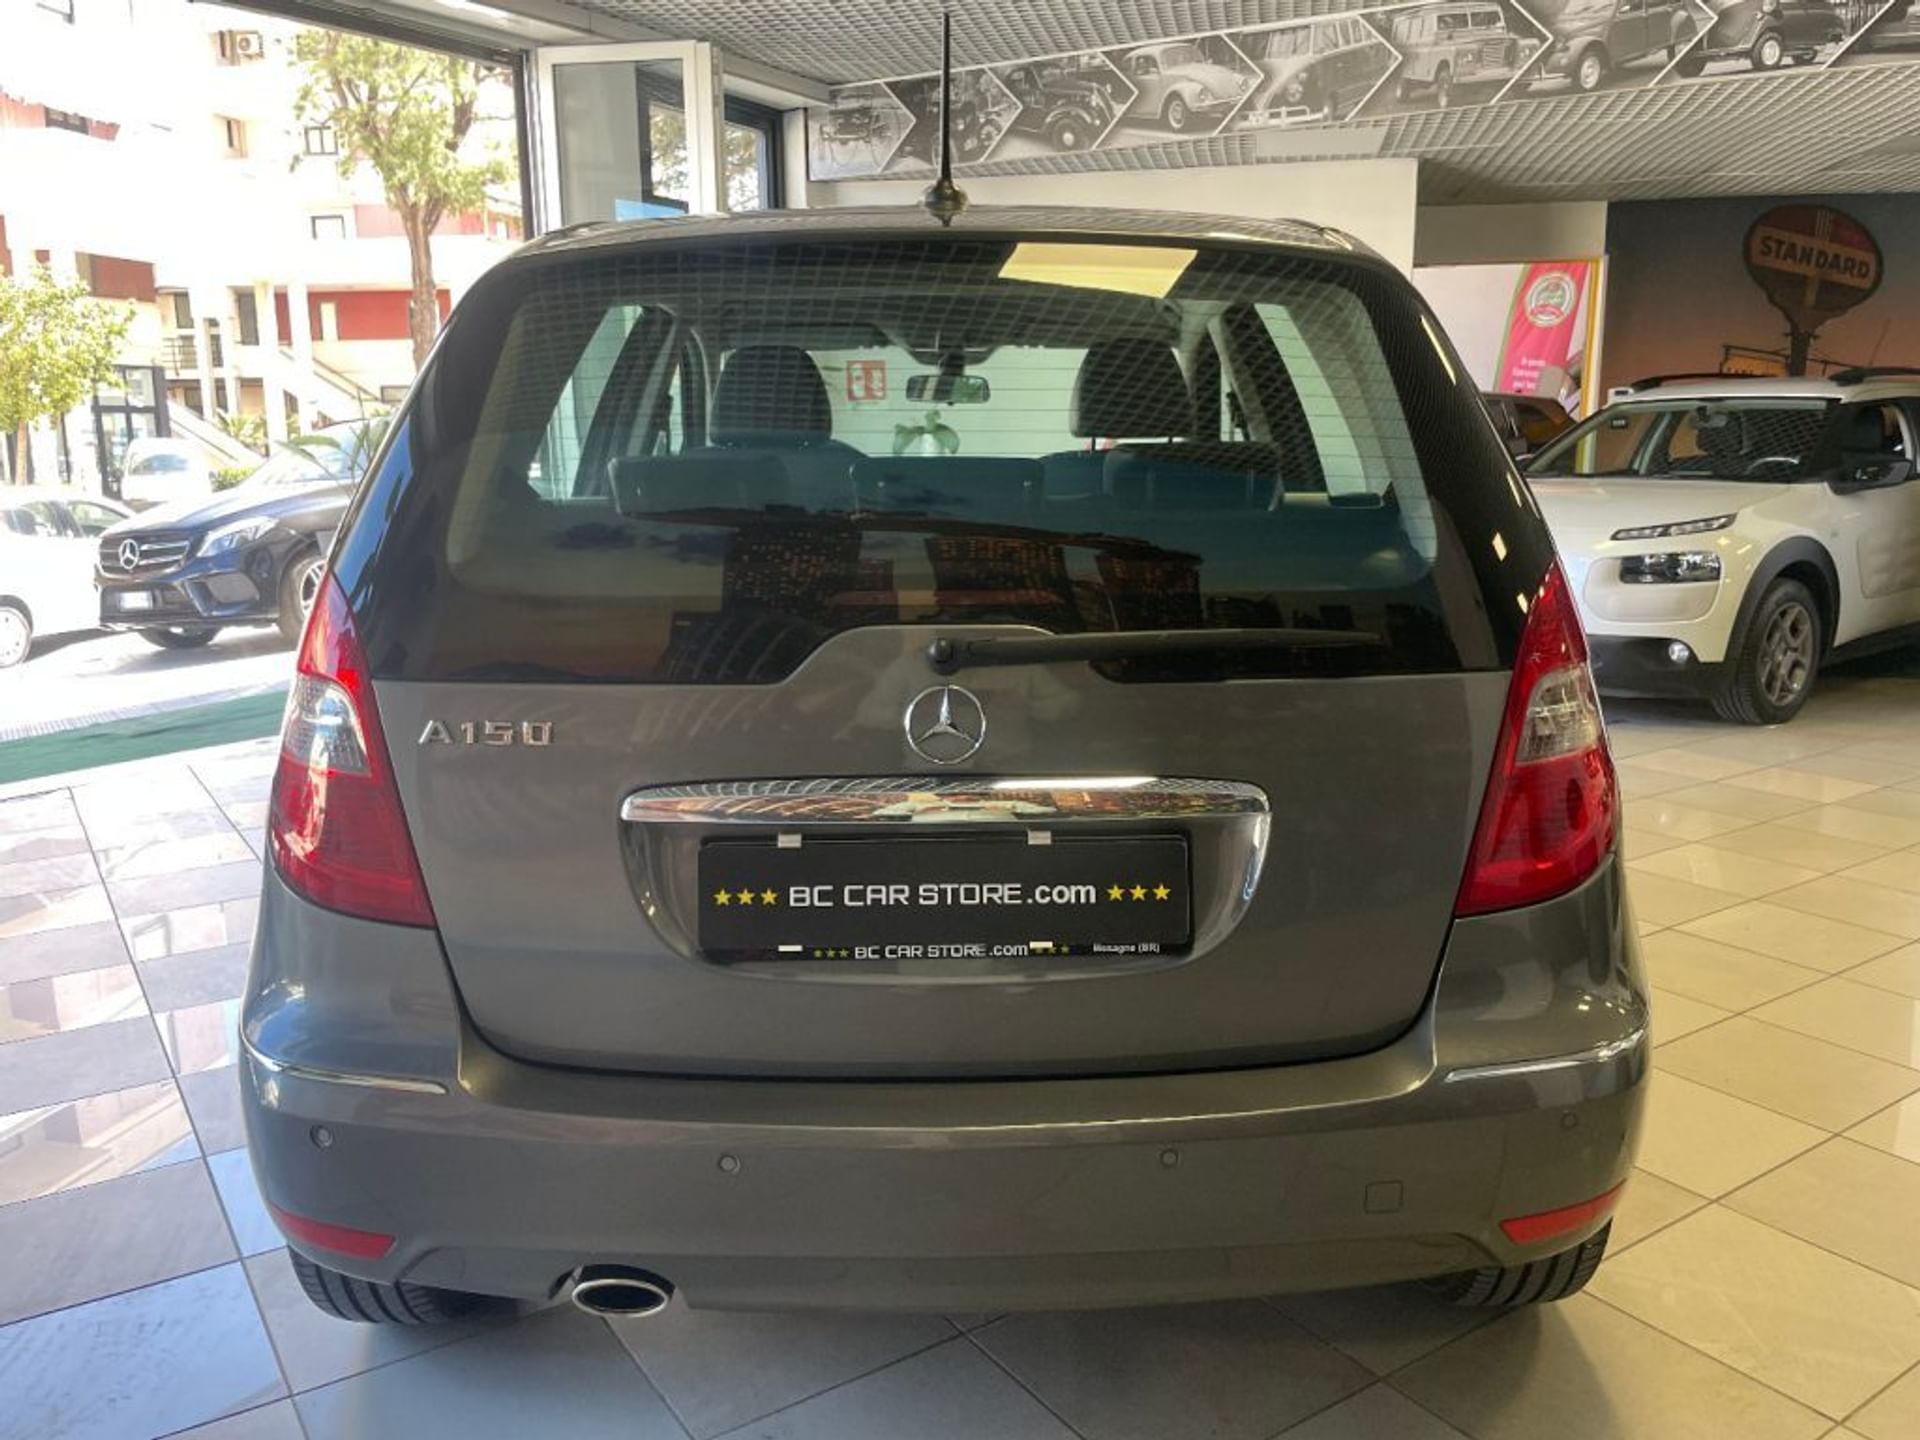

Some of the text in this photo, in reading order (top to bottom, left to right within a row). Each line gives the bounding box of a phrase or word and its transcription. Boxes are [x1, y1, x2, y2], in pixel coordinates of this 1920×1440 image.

[1759, 235, 1870, 278] STANDARD
[418, 719, 552, 746] A150
[789, 885, 834, 907] BC
[843, 884, 910, 906] CAR
[854, 946, 881, 959] BC
[884, 945, 923, 958] CAR
